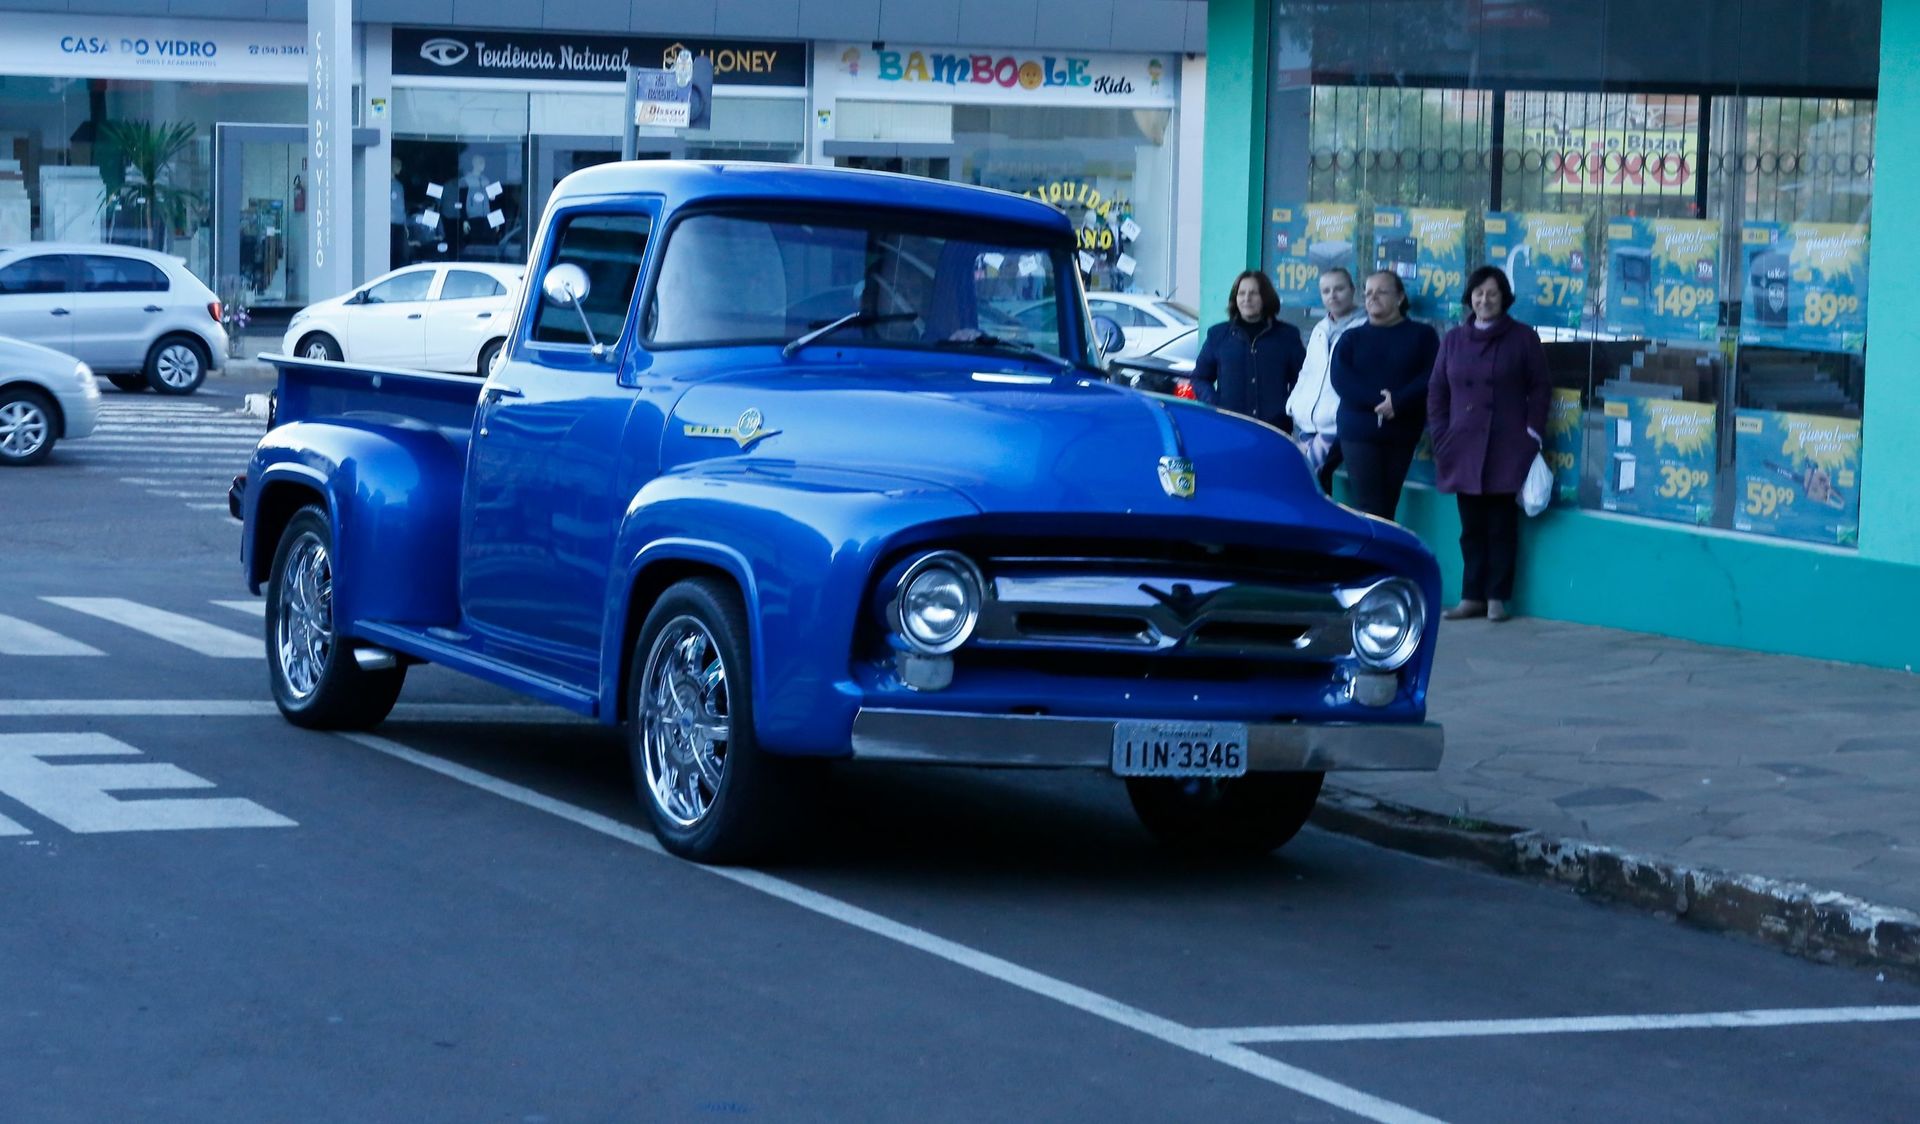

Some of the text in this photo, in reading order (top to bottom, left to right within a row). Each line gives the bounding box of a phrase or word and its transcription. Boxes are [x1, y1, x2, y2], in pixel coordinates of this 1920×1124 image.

[60, 36, 217, 57] CASA DO VIDRO
[475, 41, 630, 73] Tendência Natural
[877, 50, 1092, 90] BAMBOOLE
[1094, 75, 1135, 95] Kids
[315, 31, 324, 268] CASA DO VIDRO
[1628, 135, 1688, 149] Bazar
